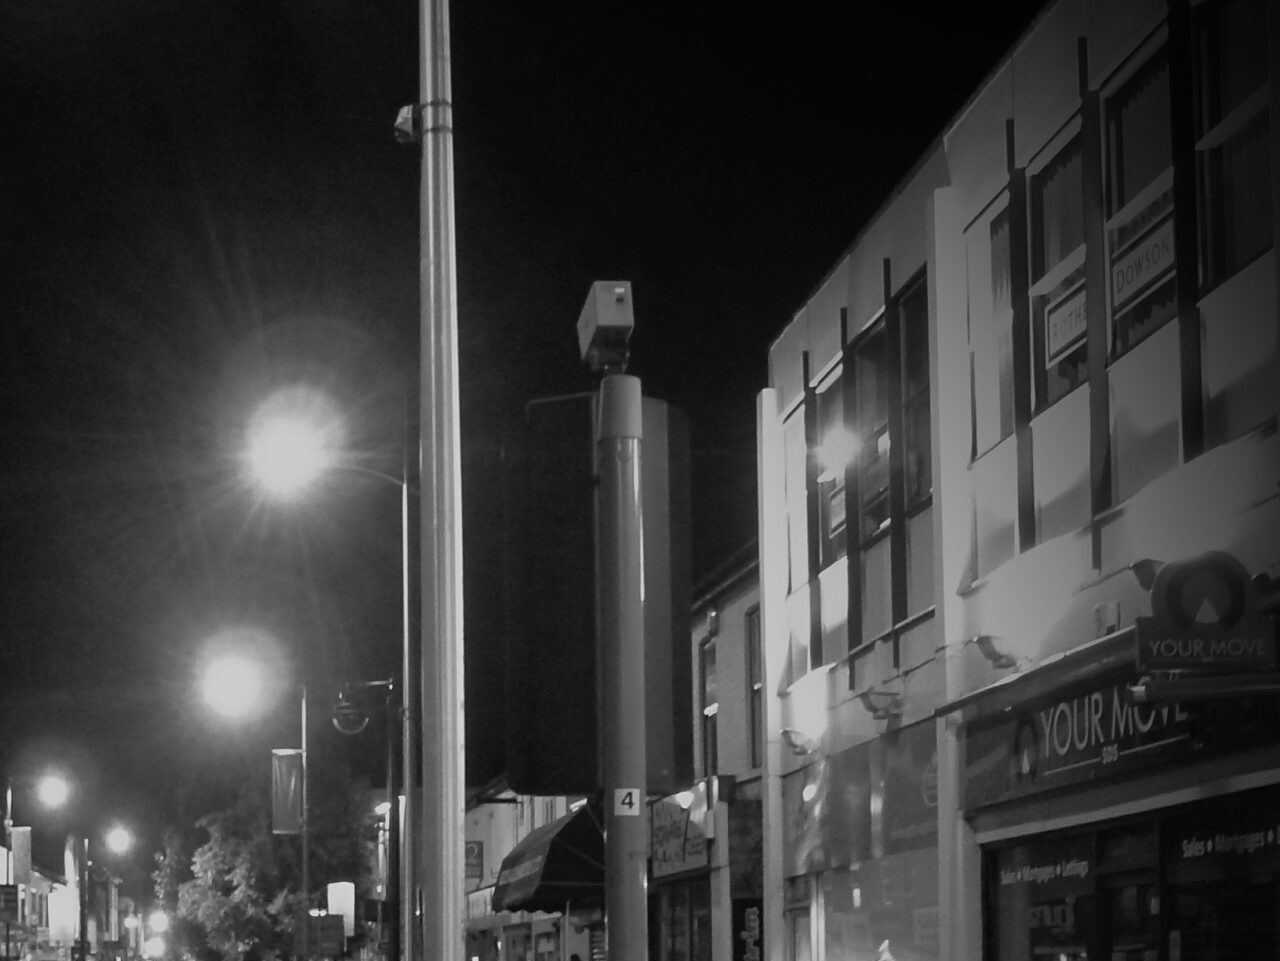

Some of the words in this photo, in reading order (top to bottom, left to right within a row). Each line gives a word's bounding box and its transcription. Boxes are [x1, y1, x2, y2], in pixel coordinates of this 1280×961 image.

[1116, 240, 1170, 294] DOWSON
[1148, 639, 1204, 657] YOUR
[1209, 637, 1267, 657] MOVE
[1040, 692, 1105, 759] YOUR
[621, 792, 634, 809] 4
